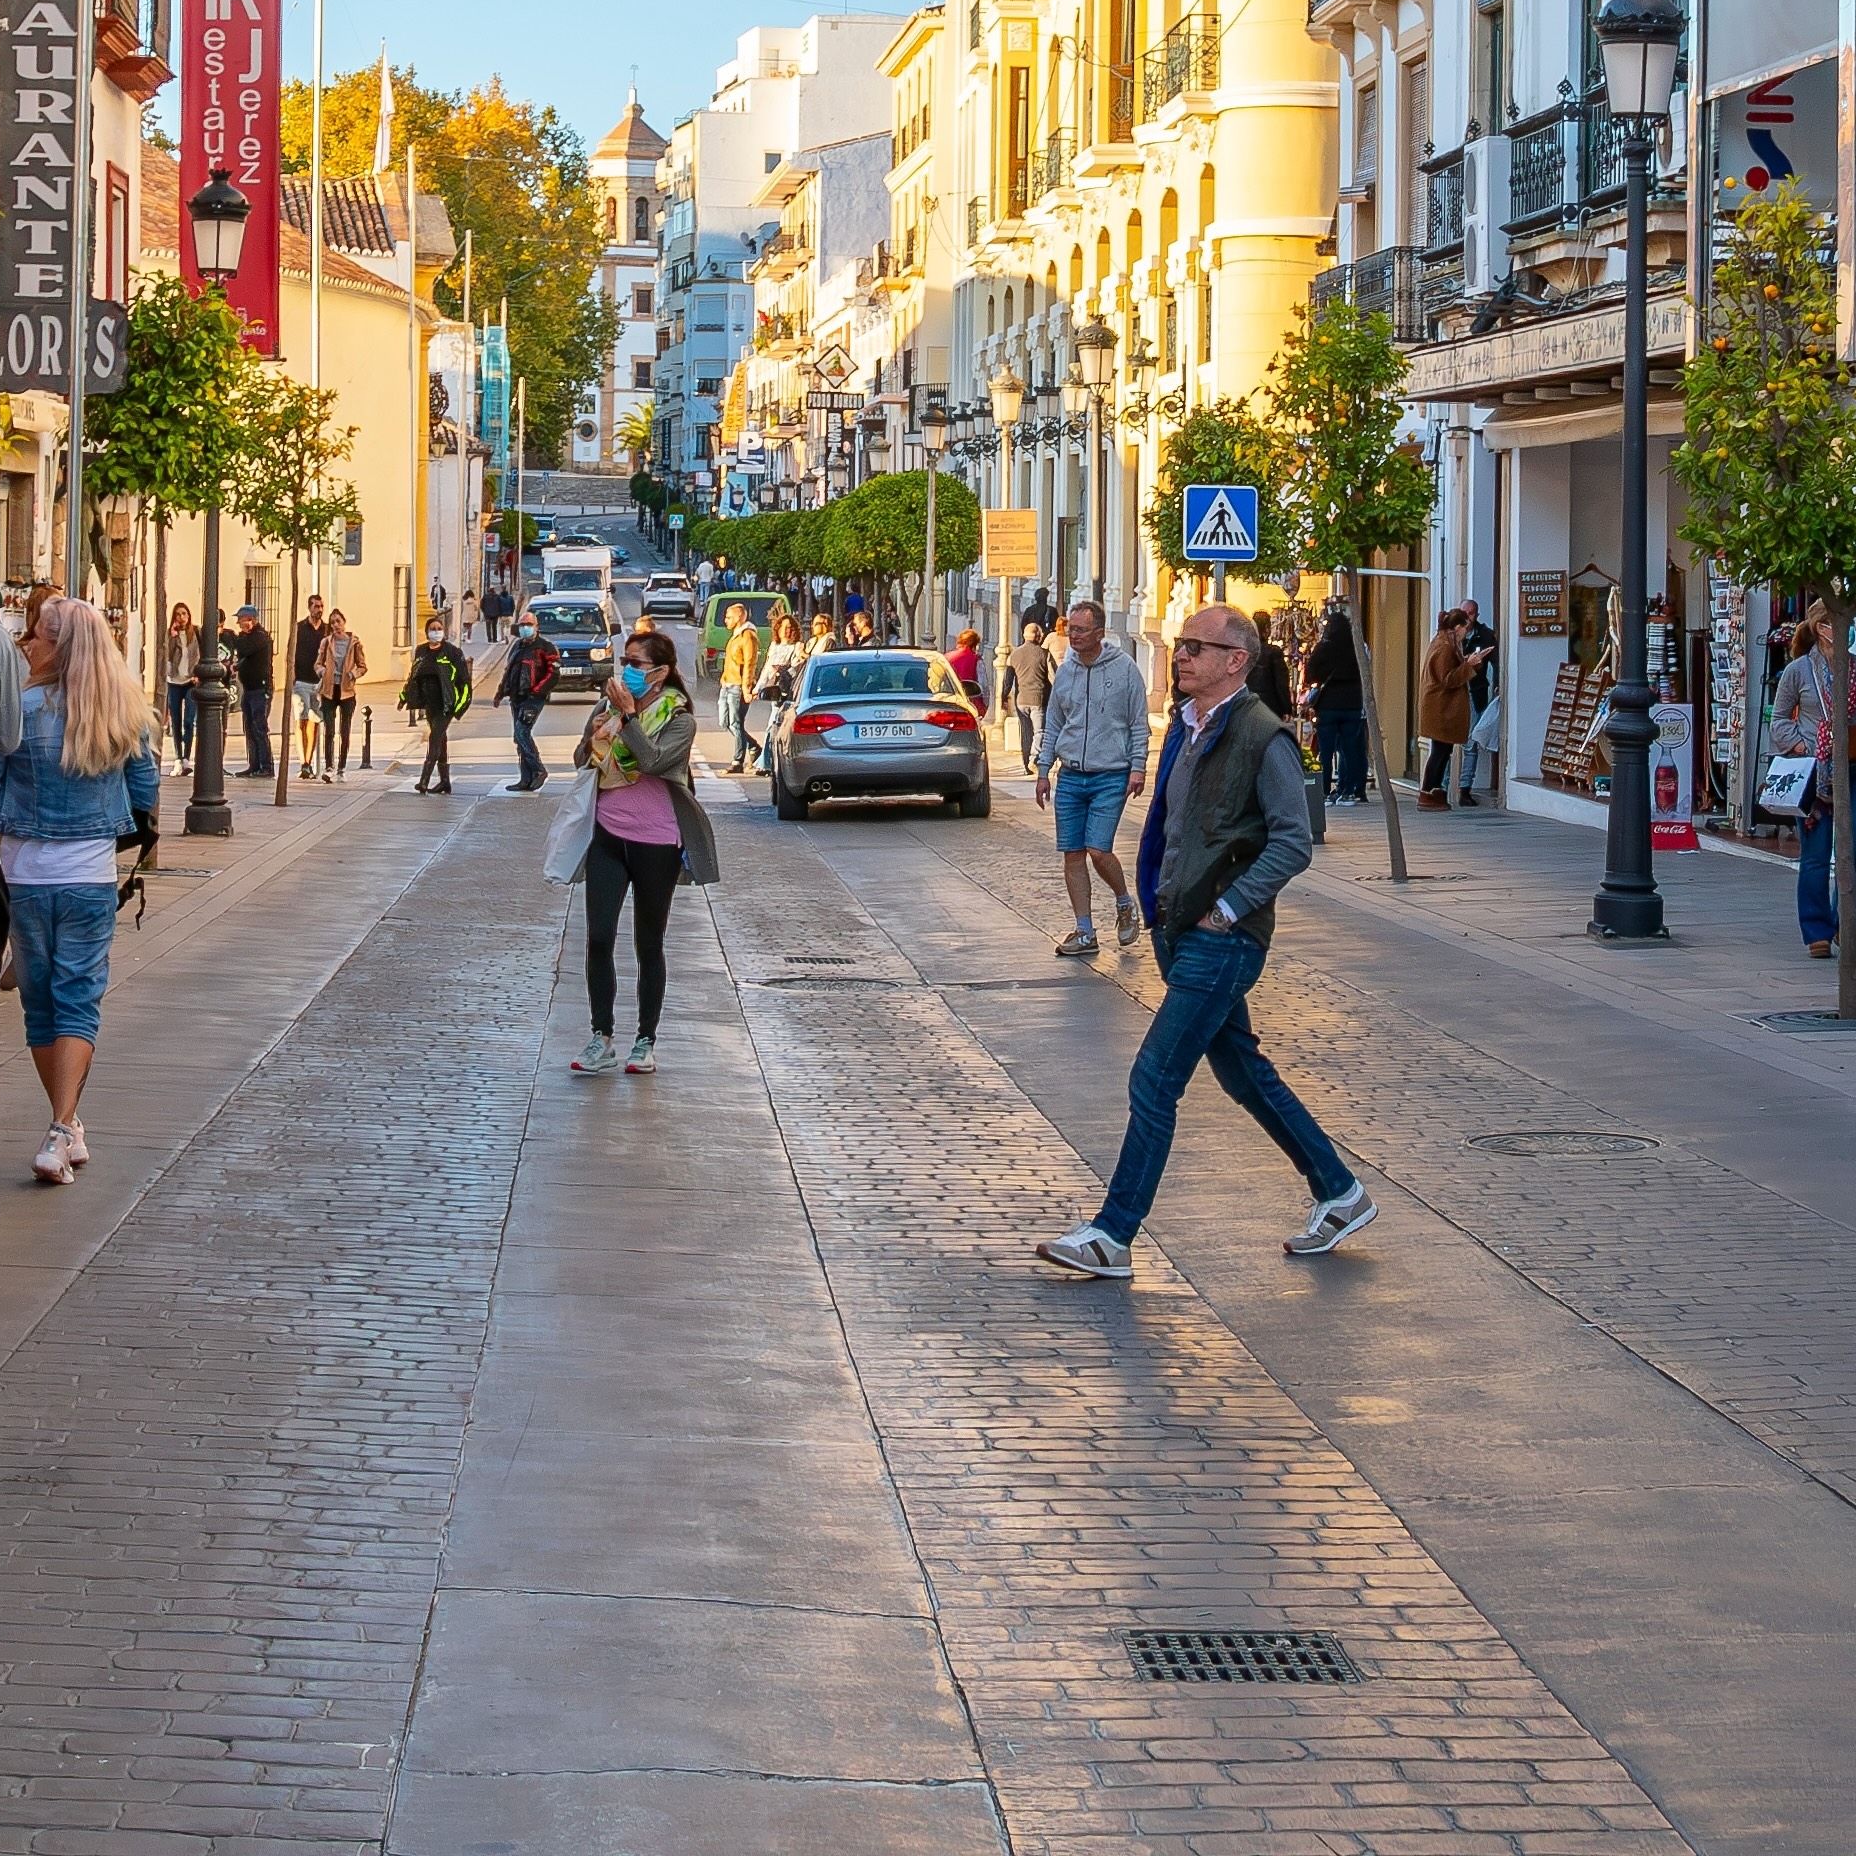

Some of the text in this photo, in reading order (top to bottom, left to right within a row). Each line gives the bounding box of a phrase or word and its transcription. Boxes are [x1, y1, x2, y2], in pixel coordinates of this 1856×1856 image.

[235, 39, 263, 185] Jerez
[860, 725, 913, 737] 8197 GND
